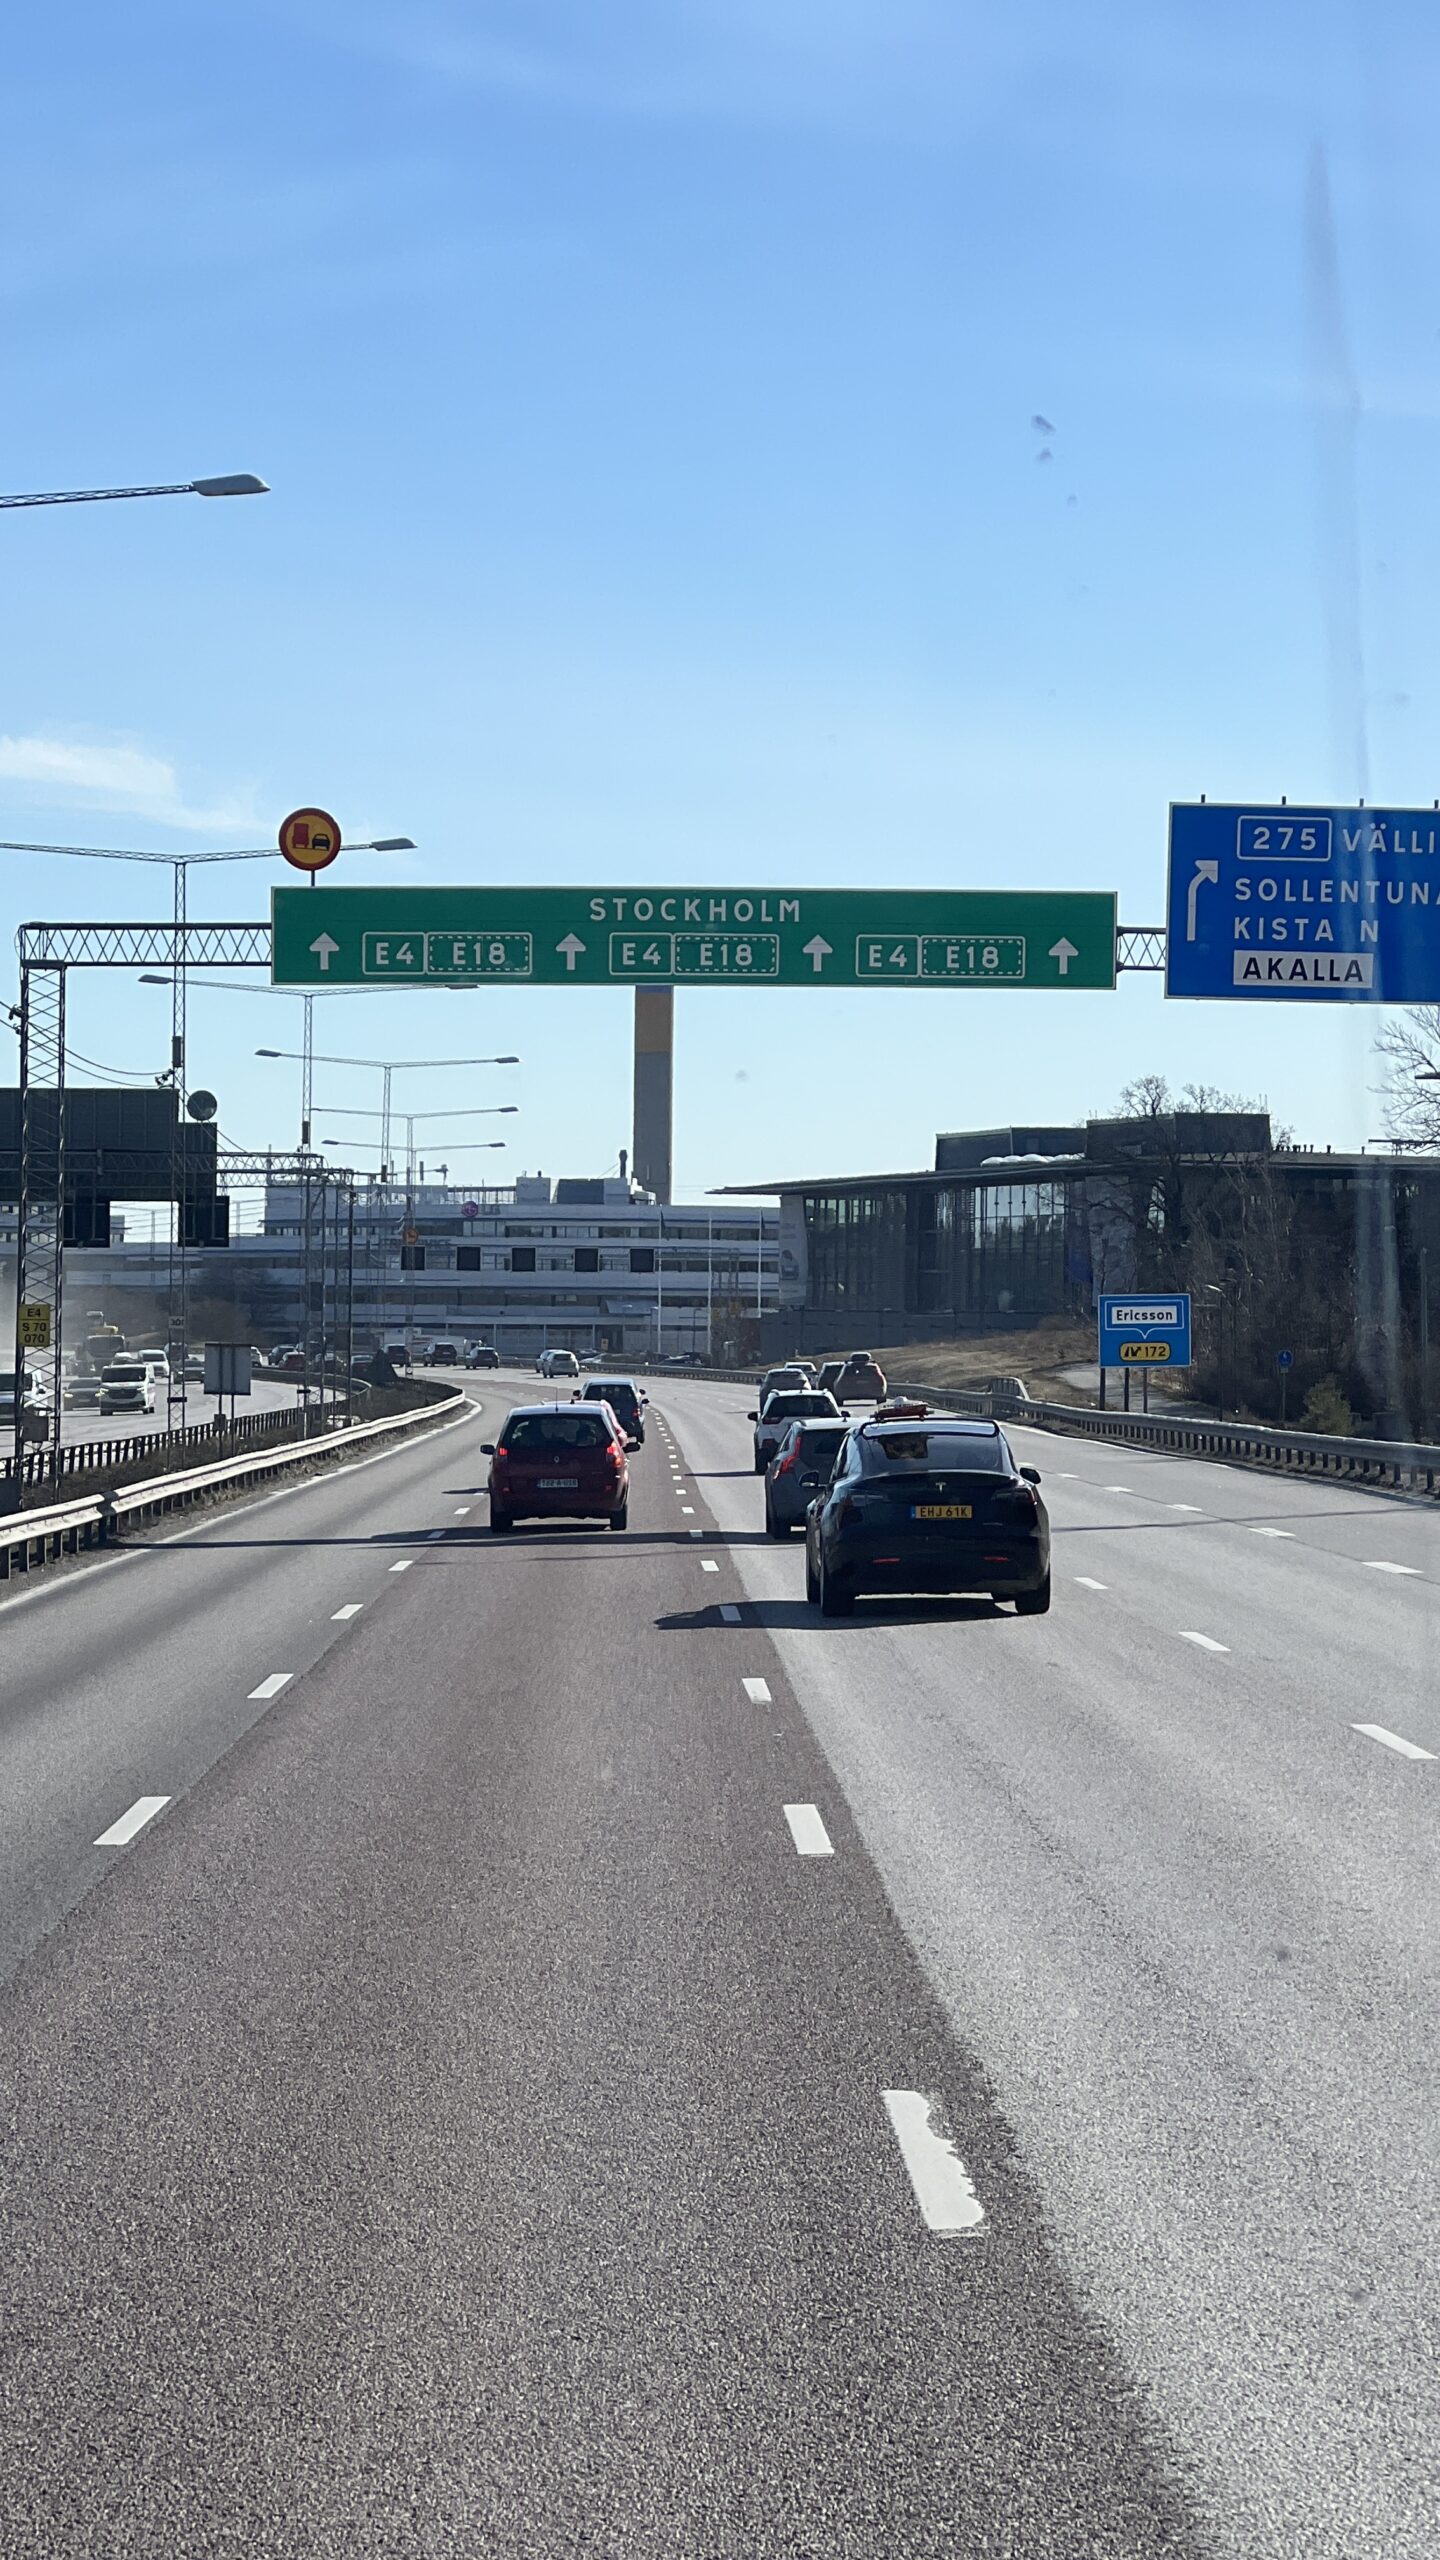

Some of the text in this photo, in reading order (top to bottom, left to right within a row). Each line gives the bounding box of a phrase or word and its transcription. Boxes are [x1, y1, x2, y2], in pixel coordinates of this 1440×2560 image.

[1253, 822, 1435, 854] 275 VÄLLI
[1235, 877, 1440, 905] SOLLENTUN
[589, 897, 801, 923] STOCKHOLM
[1234, 916, 1379, 943] KISTA N
[375, 942, 999, 969] E4 E18 E4 E18 E4 E18
[1242, 957, 1364, 982] AKALLA
[27, 1308, 41, 1318] E4
[1116, 1309, 1173, 1321] Ericsson
[22, 1322, 47, 1332] S 70
[24, 1333, 45, 1344] 070
[1145, 1345, 1167, 1358] 172
[920, 1507, 942, 1518] EHJ
